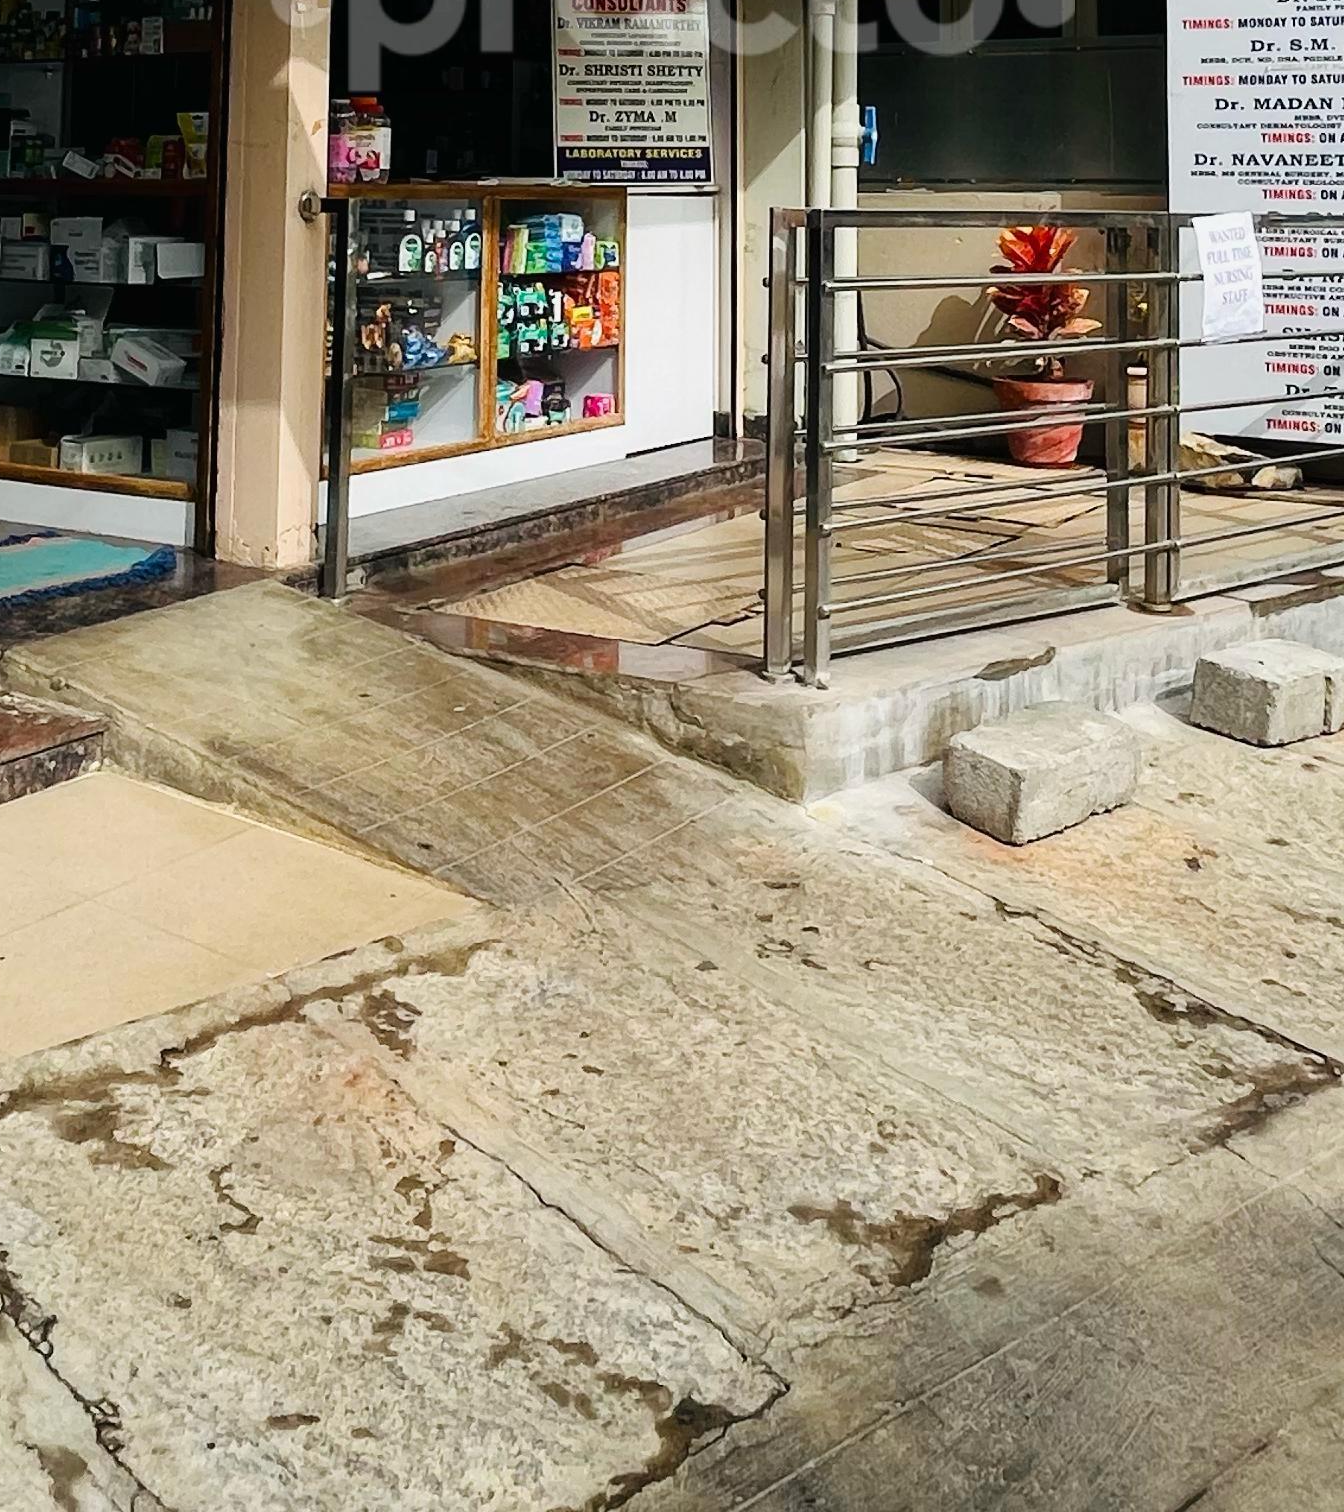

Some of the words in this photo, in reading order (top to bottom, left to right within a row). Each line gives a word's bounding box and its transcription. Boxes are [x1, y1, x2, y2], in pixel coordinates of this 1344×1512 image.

[559, 64, 580, 76] Dr.
[584, 65, 642, 77] SHRISTI
[647, 65, 703, 77] SHETTY
[1254, 97, 1333, 110] MADAN
[615, 111, 656, 124] ZYMA
[565, 148, 641, 159] LABORATORY
[646, 149, 703, 159] SERVICES
